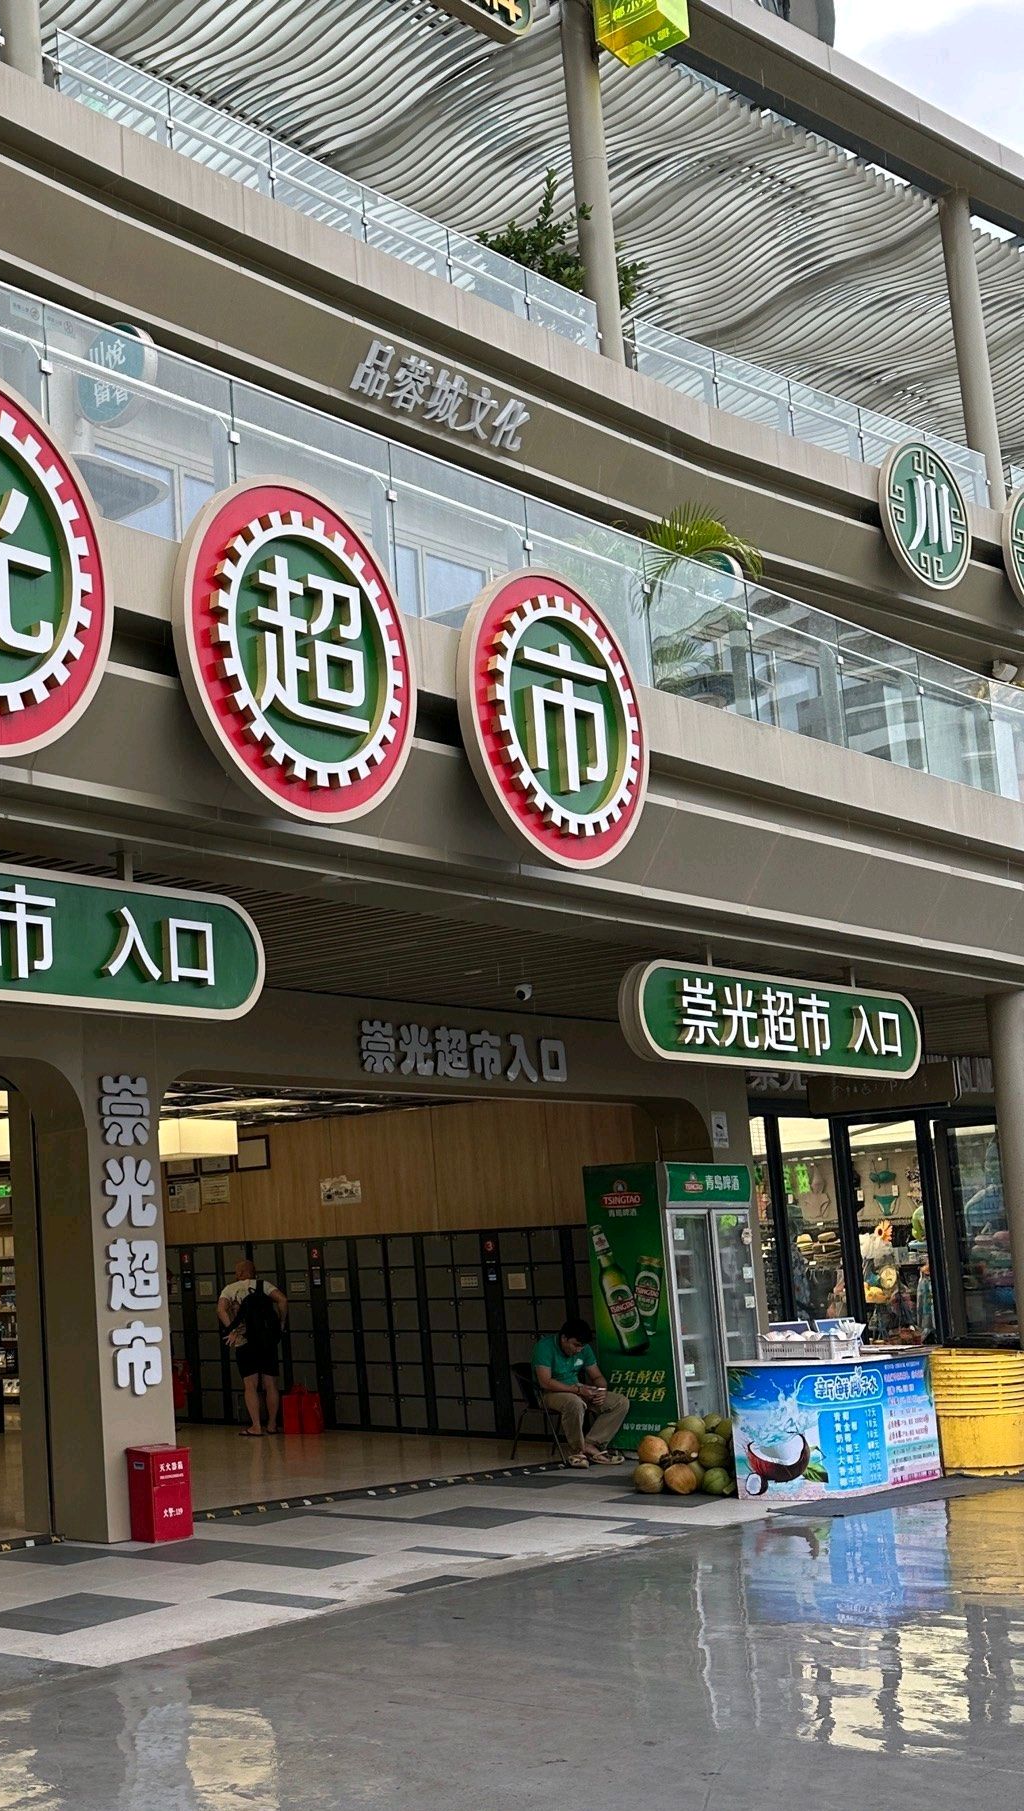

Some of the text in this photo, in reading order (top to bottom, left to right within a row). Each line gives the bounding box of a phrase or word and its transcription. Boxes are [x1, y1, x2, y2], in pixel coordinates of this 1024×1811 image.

[349, 340, 530, 452] 品蓉城文化
[906, 474, 953, 554] 川
[250, 555, 370, 734] 超
[513, 643, 608, 793] 市
[102, 906, 216, 987] 入口
[360, 1019, 568, 1083] 崇光超市入口
[679, 977, 903, 1058] 崇光超市 入口
[603, 1194, 641, 1204] TSINGTAO
[608, 1209, 638, 1218] 青岛啤酒
[705, 1174, 740, 1191] 青岛啤酒
[101, 1074, 163, 1396] 崇光超市
[610, 1370, 665, 1384] 百年酵母
[160, 1461, 184, 1472] 灭火器箱
